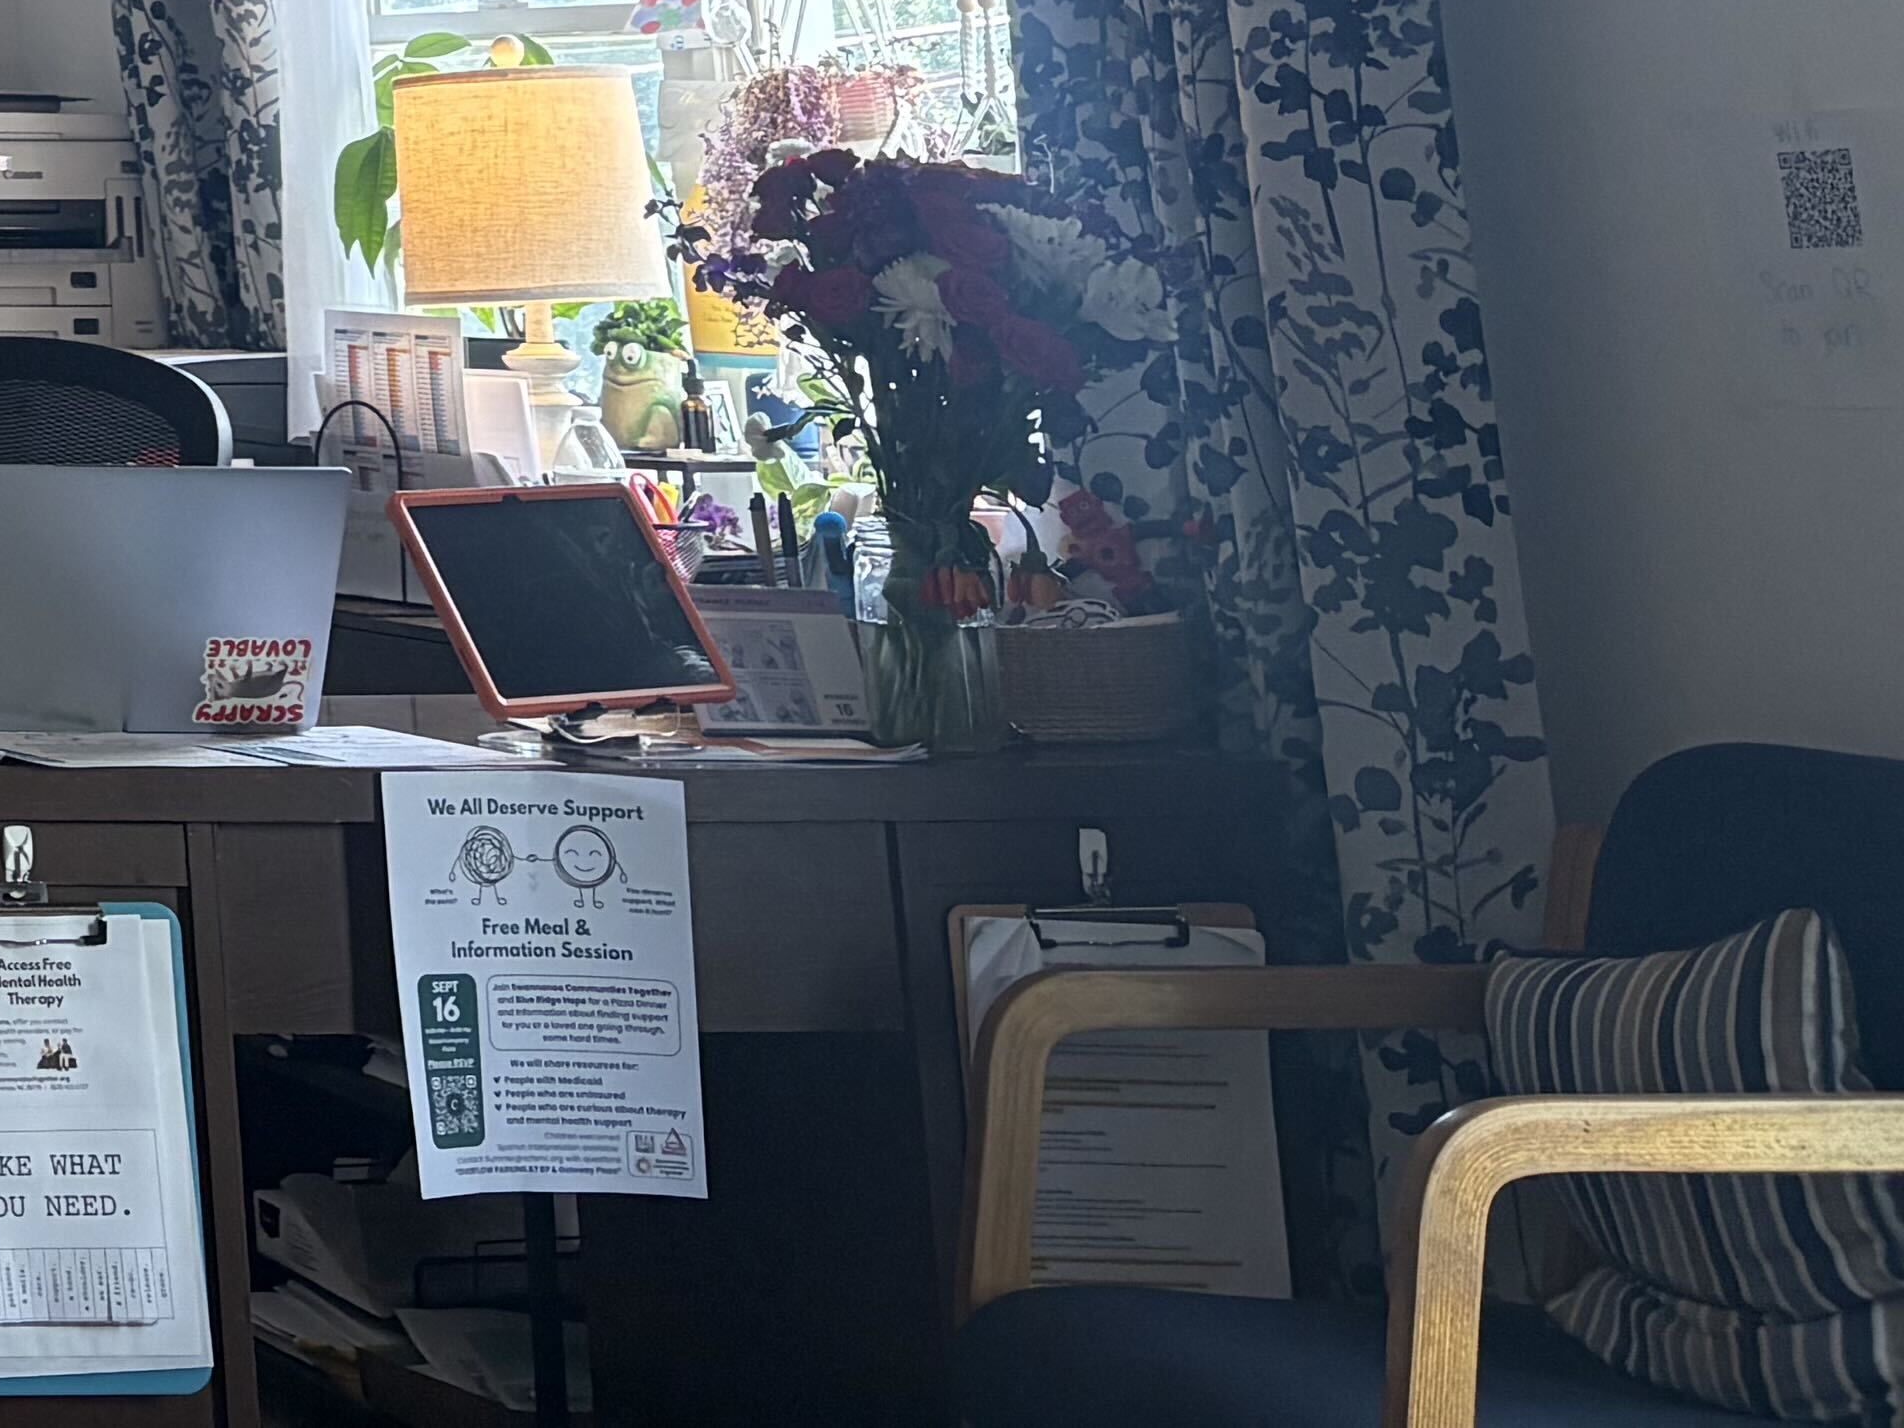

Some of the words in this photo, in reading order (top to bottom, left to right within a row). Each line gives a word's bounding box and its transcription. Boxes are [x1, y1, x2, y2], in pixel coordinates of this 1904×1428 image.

[206, 639, 312, 658] LOVABLE
[195, 703, 303, 723] SCRAPPY
[427, 798, 456, 815] We
[460, 798, 482, 815] All
[488, 799, 558, 815] Deserve
[563, 799, 644, 822] Support
[482, 918, 520, 936] Free
[525, 918, 569, 936] Meal
[574, 919, 591, 937] &
[451, 941, 556, 959] Information
[561, 942, 633, 961] Session
[43, 958, 72, 971] Free
[38, 974, 81, 987] Health
[432, 980, 459, 993] SEPT
[7, 992, 64, 1008] Therapy
[432, 996, 460, 1022] 16
[49, 1154, 122, 1175] WHAT
[44, 1194, 131, 1217] NEED.
